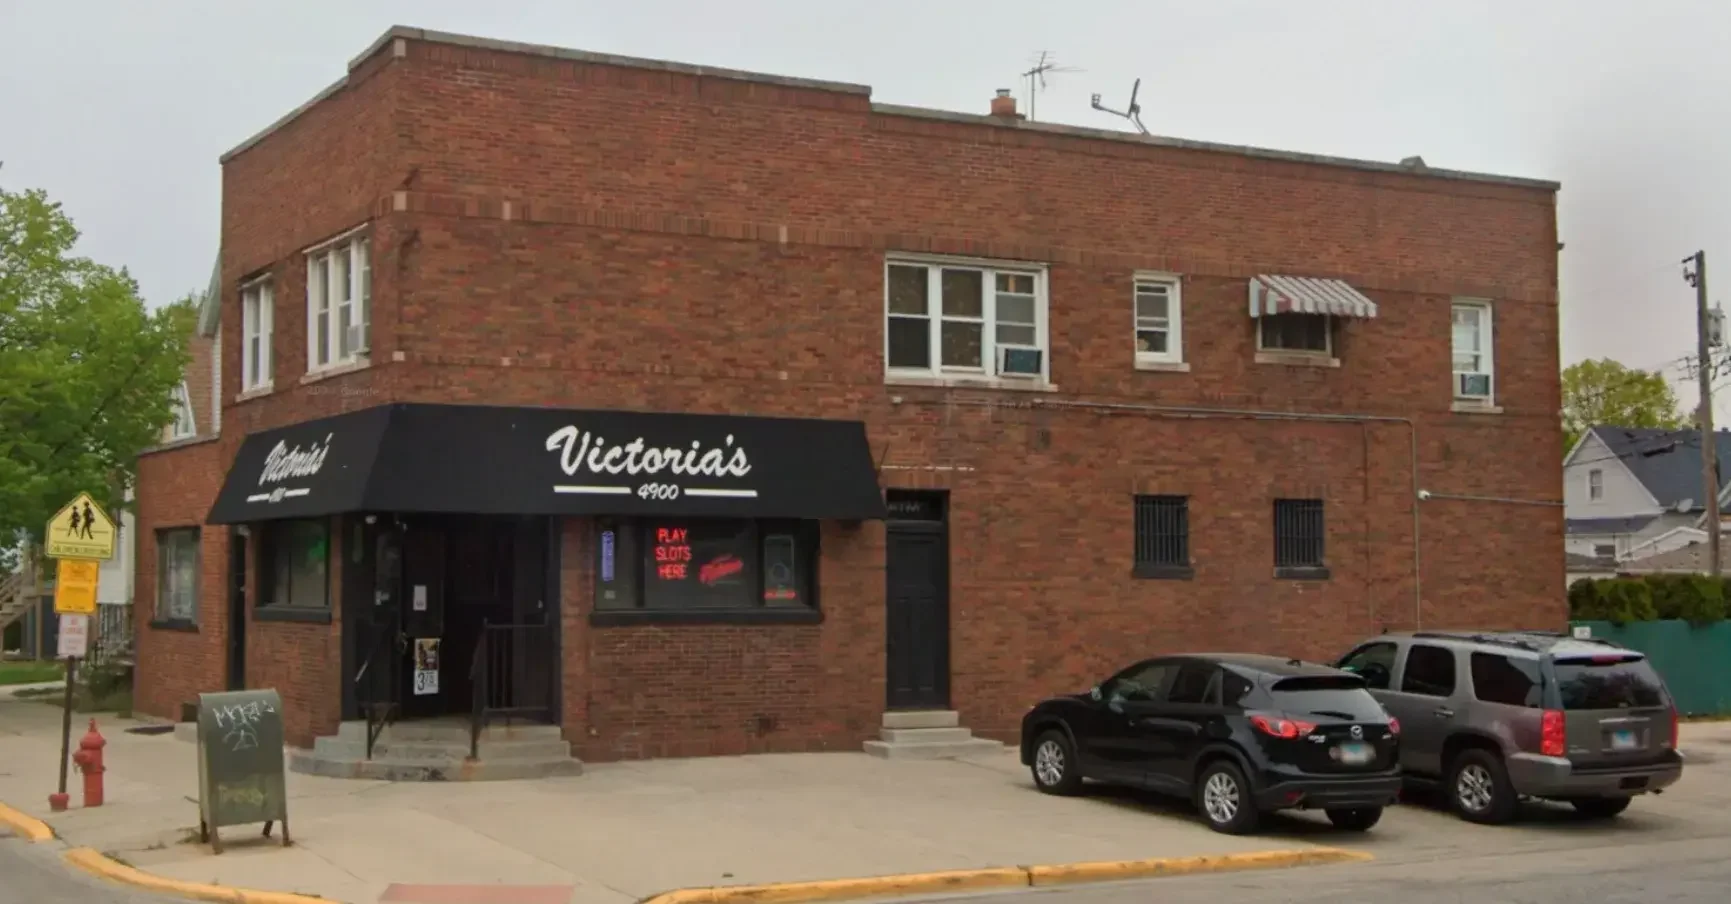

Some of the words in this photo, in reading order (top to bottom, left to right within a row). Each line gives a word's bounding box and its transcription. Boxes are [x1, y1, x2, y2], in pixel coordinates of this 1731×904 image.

[546, 425, 752, 477] Victoria's
[637, 482, 680, 500] 4900
[656, 527, 688, 543] PLAY
[655, 546, 692, 562] SLOTS
[657, 564, 688, 580] HERE
